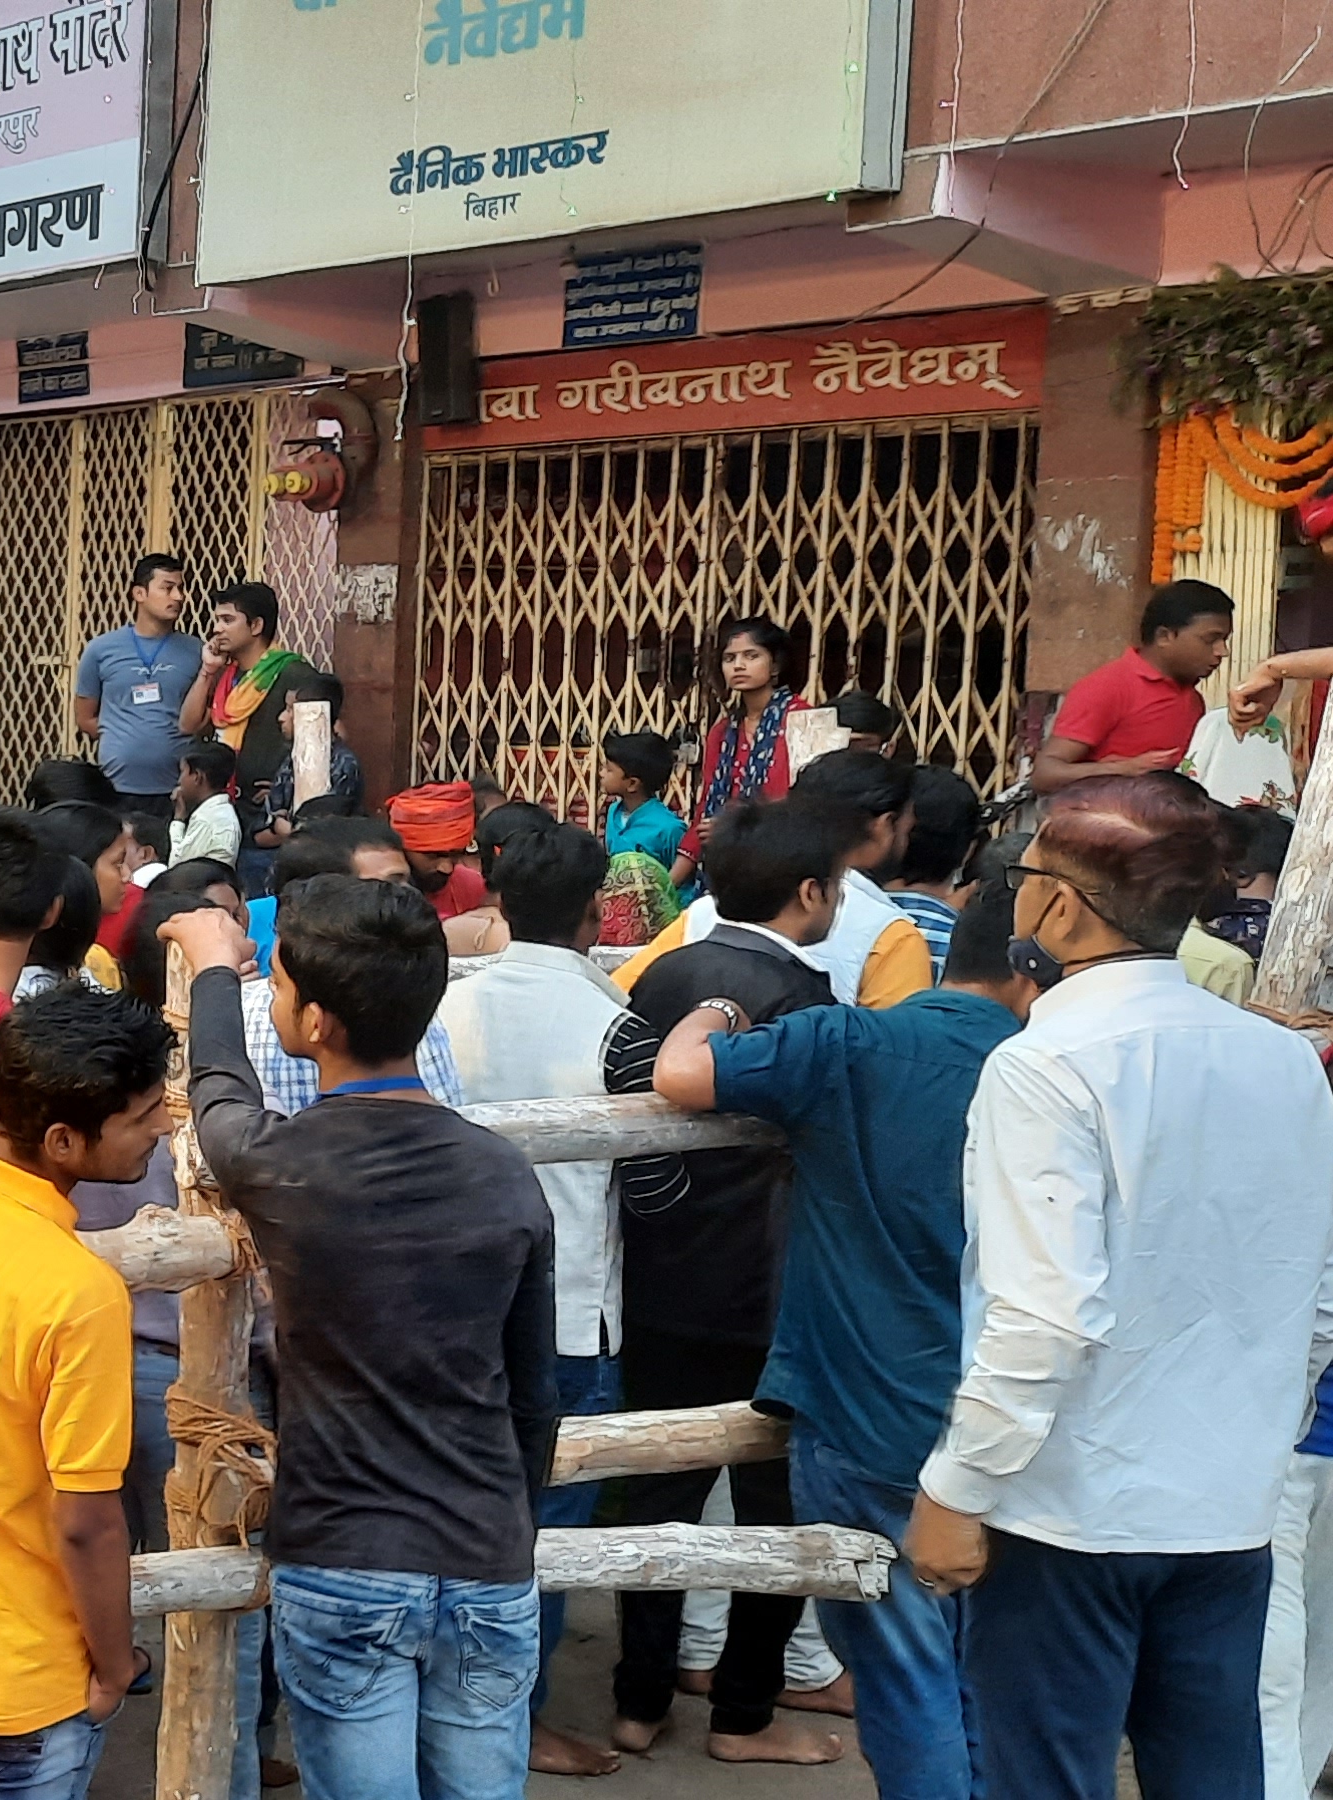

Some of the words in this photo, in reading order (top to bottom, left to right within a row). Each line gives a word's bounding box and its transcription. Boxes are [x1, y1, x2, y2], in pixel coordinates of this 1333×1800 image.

[389, 145, 484, 198] दैनिक
[492, 128, 610, 178] भास्कर
[464, 192, 522, 222] बिहार
[556, 359, 792, 416] गरीबनाथ
